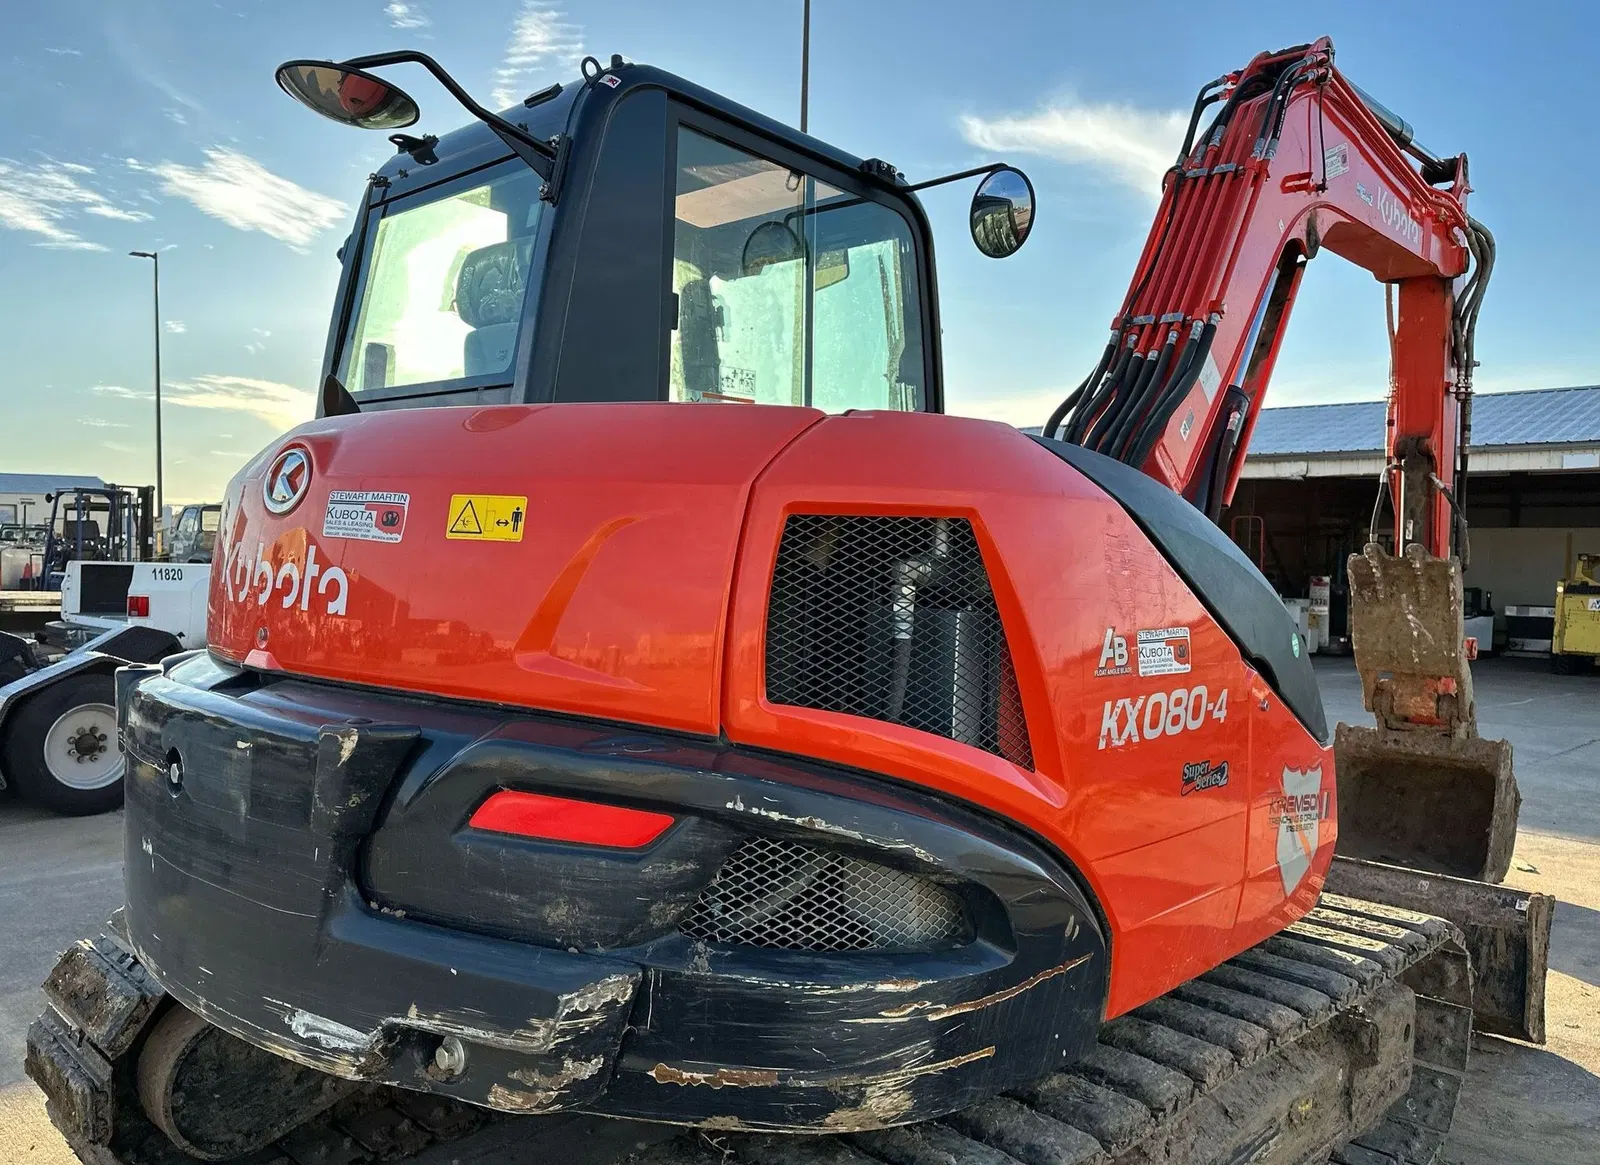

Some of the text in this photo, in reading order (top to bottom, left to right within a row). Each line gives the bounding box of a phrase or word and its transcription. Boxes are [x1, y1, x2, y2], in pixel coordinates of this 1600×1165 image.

[1377, 186, 1419, 244] Kubota
[330, 491, 408, 502] STEWART MARTIN
[326, 506, 373, 521] KUBOTA
[151, 568, 183, 581] 11820
[221, 541, 349, 616] Kubota
[1138, 628, 1189, 640] STEWART MARTIN
[1098, 627, 1129, 668] AB
[1139, 646, 1173, 659] KUBOTA
[1094, 669, 1107, 677] FLOAT
[1107, 668, 1120, 676] ANGLE
[1120, 667, 1132, 675] BLADE
[1098, 685, 1228, 750] KX080-4
[1183, 761, 1209, 780] Super
